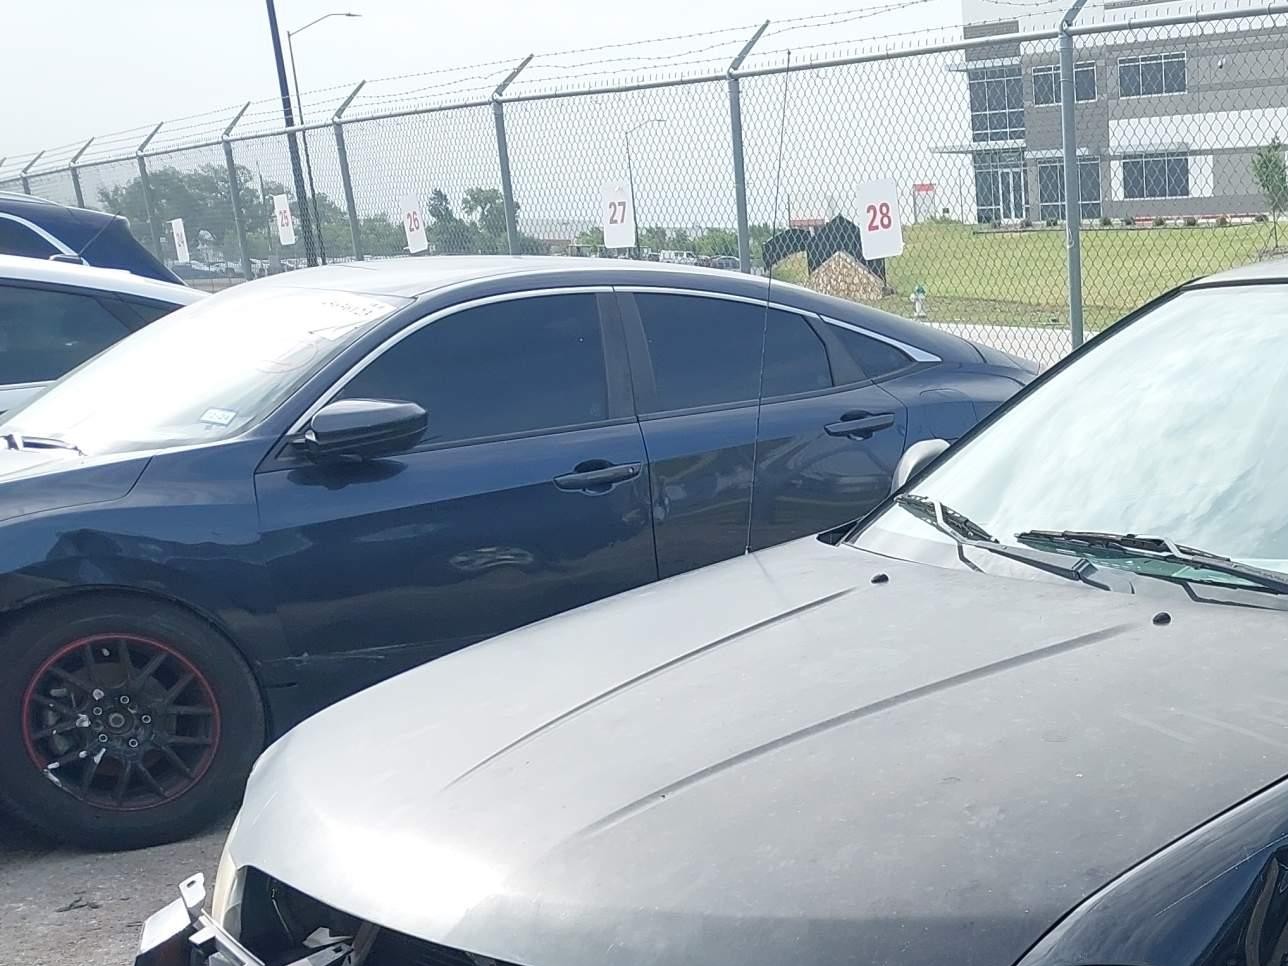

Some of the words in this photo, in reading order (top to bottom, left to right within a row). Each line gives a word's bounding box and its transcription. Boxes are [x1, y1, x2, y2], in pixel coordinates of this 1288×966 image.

[406, 210, 420, 232] 26
[608, 201, 627, 225] 27
[866, 202, 892, 232] 28
